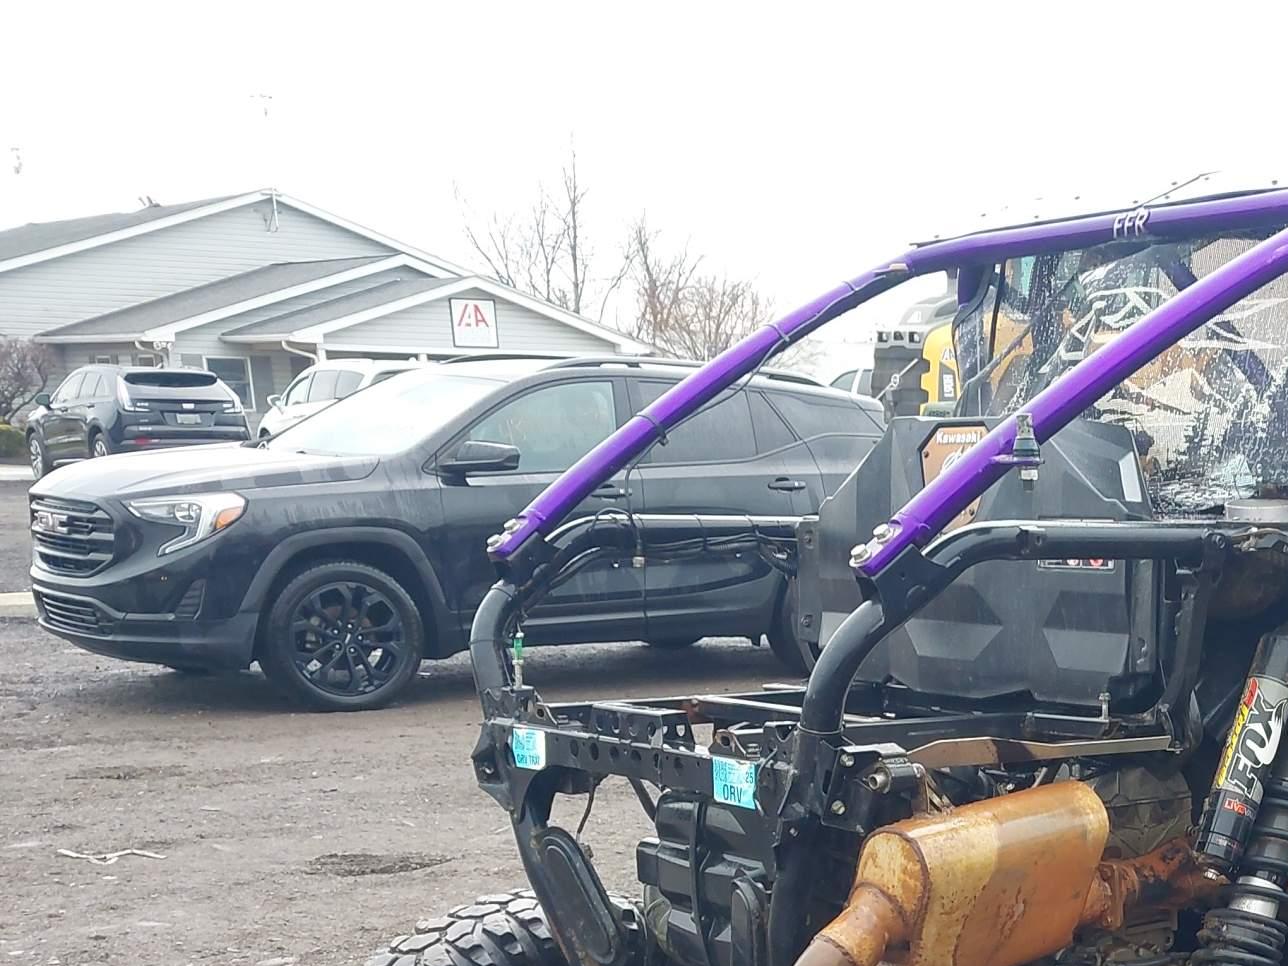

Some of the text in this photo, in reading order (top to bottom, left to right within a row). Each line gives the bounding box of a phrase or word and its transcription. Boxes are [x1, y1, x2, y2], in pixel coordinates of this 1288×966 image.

[1113, 207, 1150, 239] FFR
[1227, 687, 1279, 799] FOX
[722, 783, 743, 804] ORV
